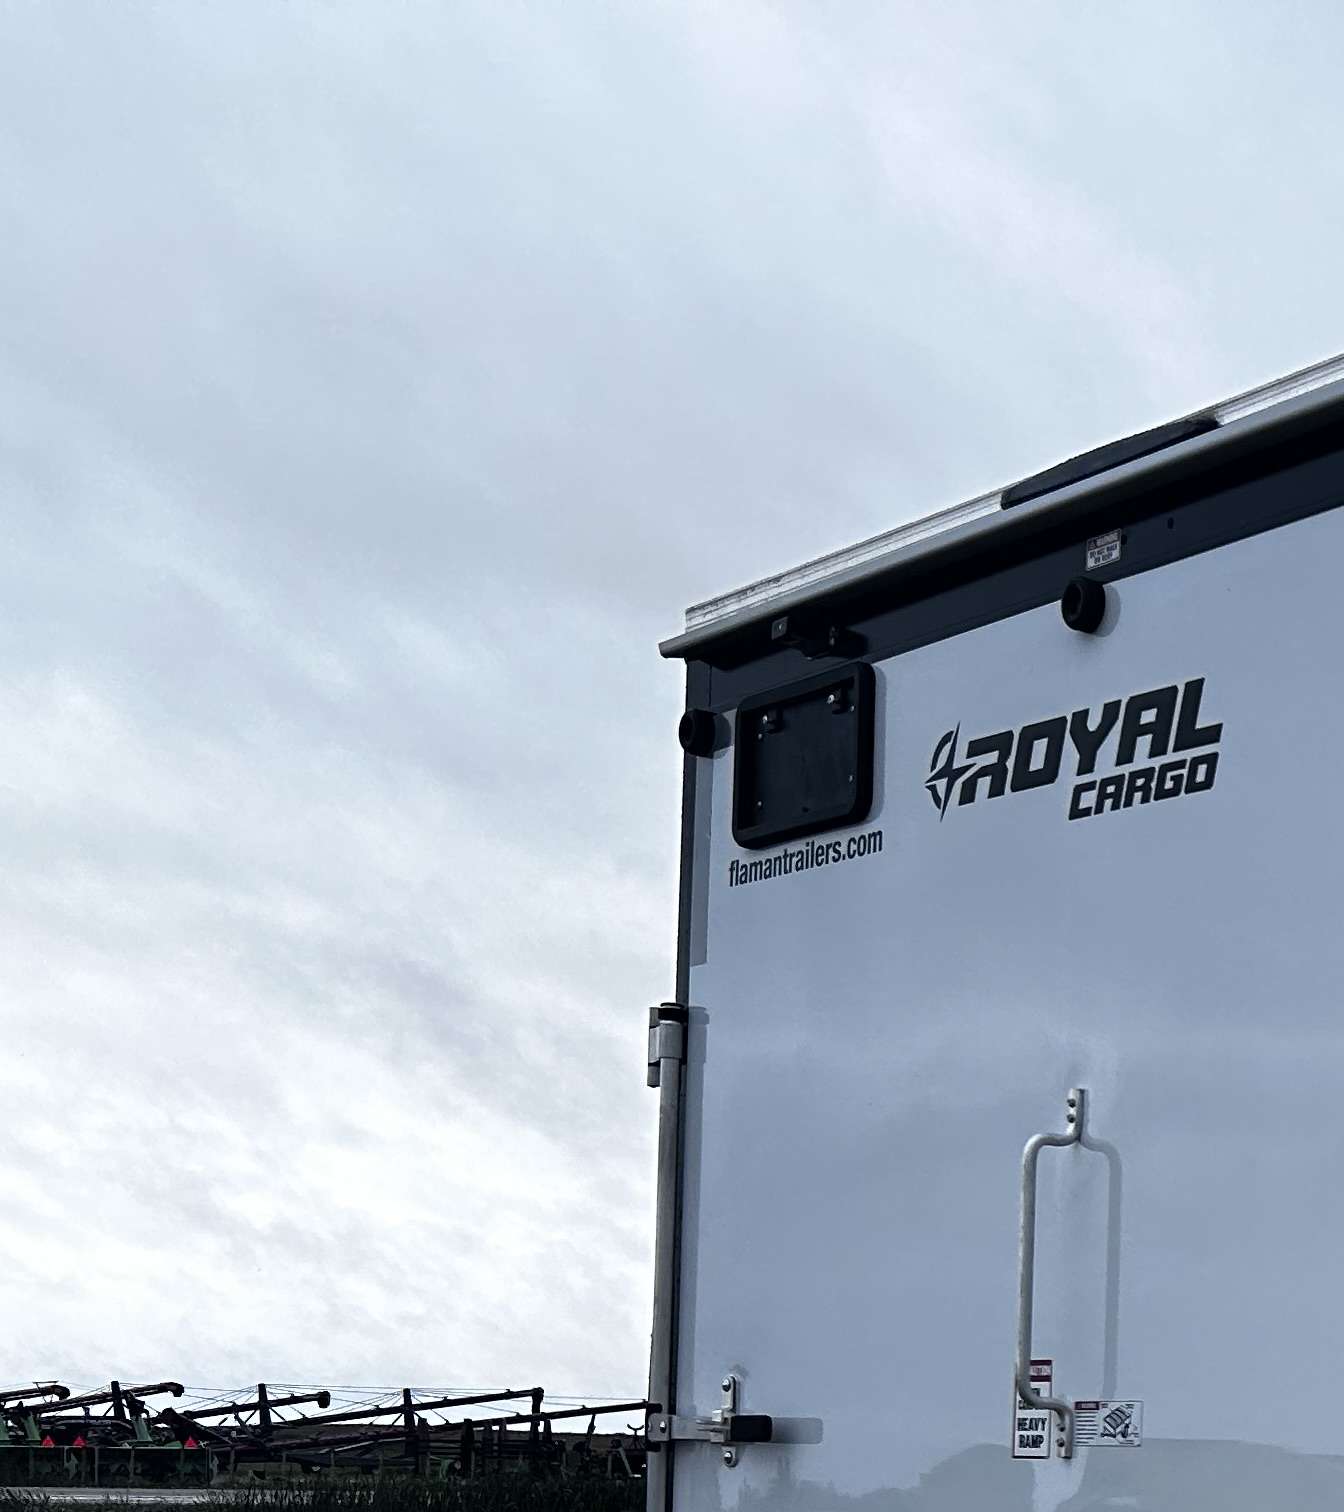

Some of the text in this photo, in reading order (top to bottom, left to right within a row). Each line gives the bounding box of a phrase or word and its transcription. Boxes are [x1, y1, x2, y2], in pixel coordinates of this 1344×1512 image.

[958, 677, 1223, 806] ROYAL
[1068, 751, 1220, 821] CARGO
[729, 827, 883, 887] flamantrailers.com
[1017, 1417, 1047, 1432] HEAVY
[1019, 1434, 1045, 1449] RAMP
